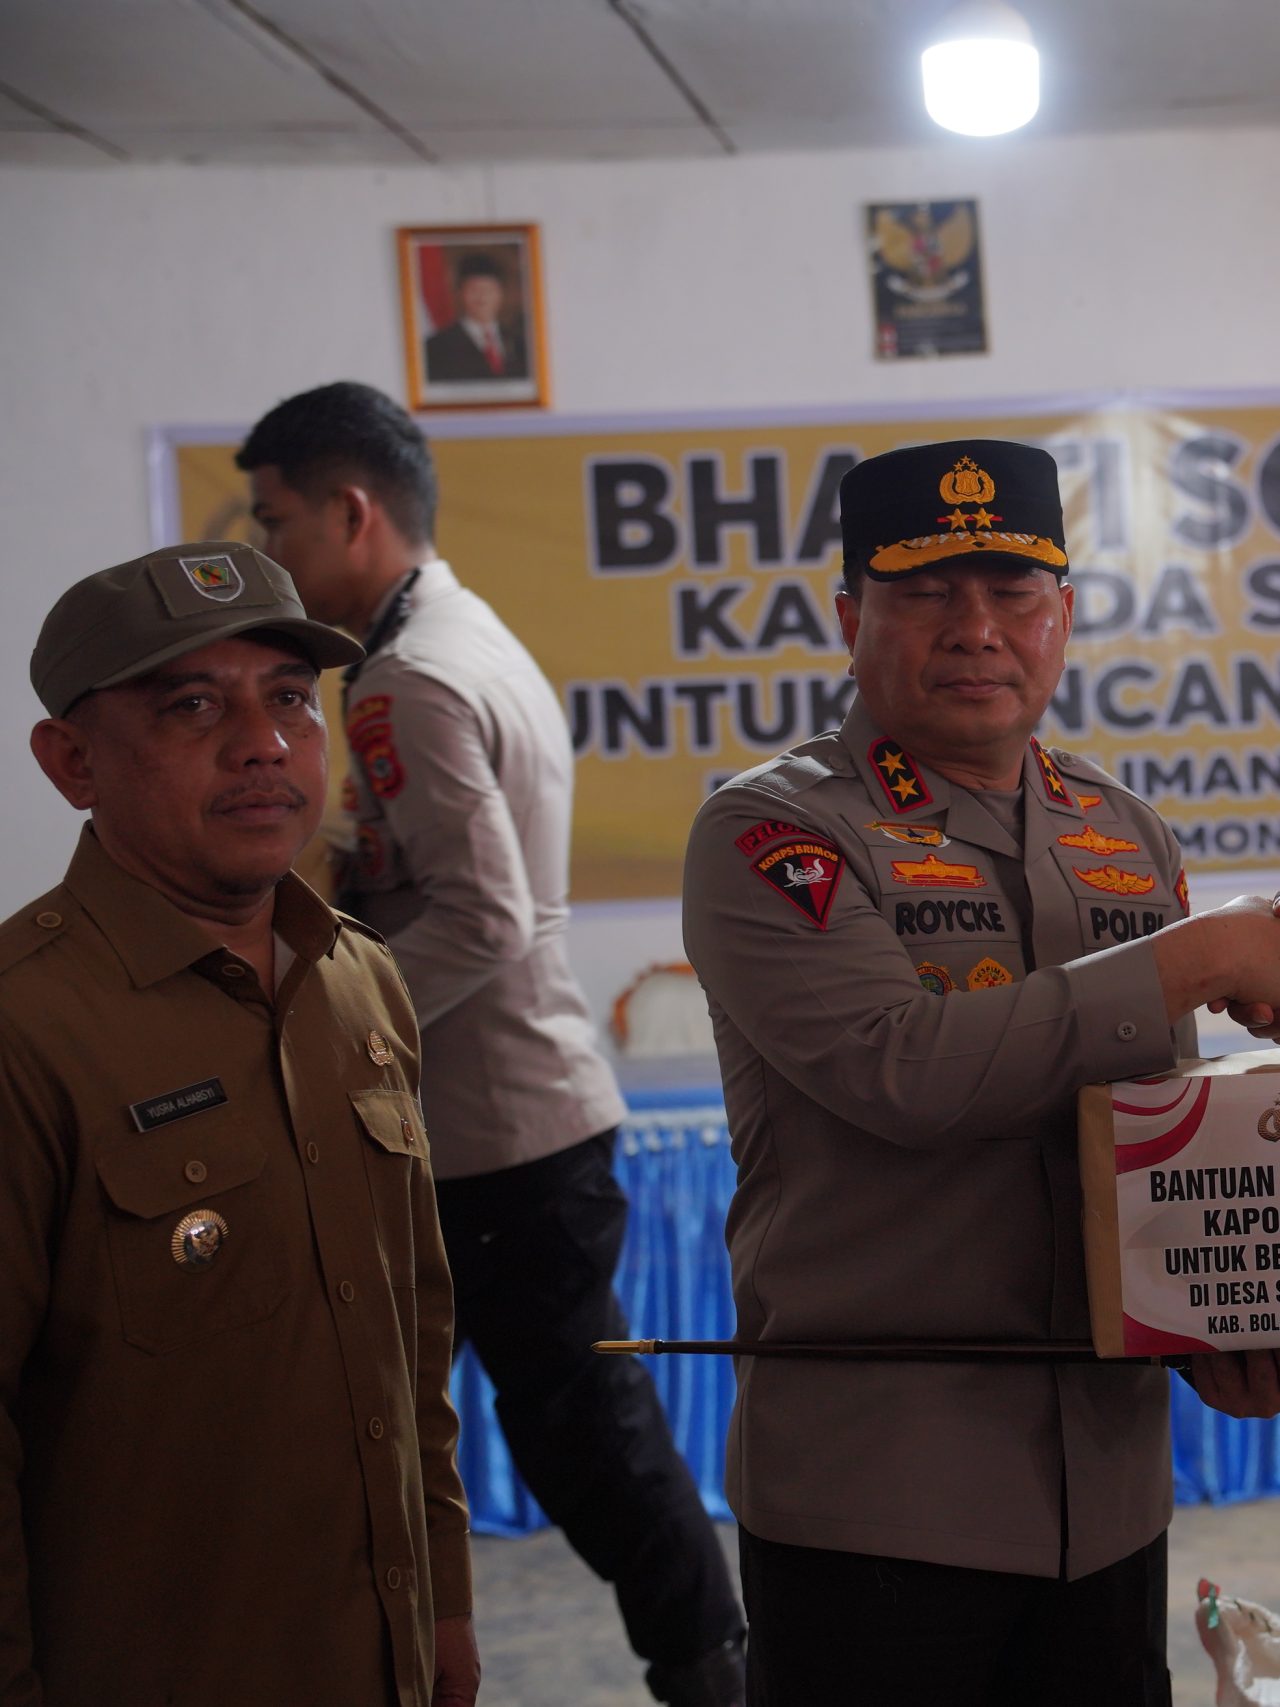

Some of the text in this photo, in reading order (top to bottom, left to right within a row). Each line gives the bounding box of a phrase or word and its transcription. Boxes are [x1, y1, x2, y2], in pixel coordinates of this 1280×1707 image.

[758, 844, 839, 871] KORPS BRIMOB
[895, 900, 1005, 936] ROYCKE
[146, 1087, 216, 1118] YUSRA ALHABSYI
[1150, 1165, 1275, 1203] BANTUAN
[1165, 1245, 1247, 1275] UNTUK
[1189, 1283, 1210, 1307] DI
[1216, 1280, 1270, 1306] DESA
[1208, 1315, 1245, 1335] KAB.
